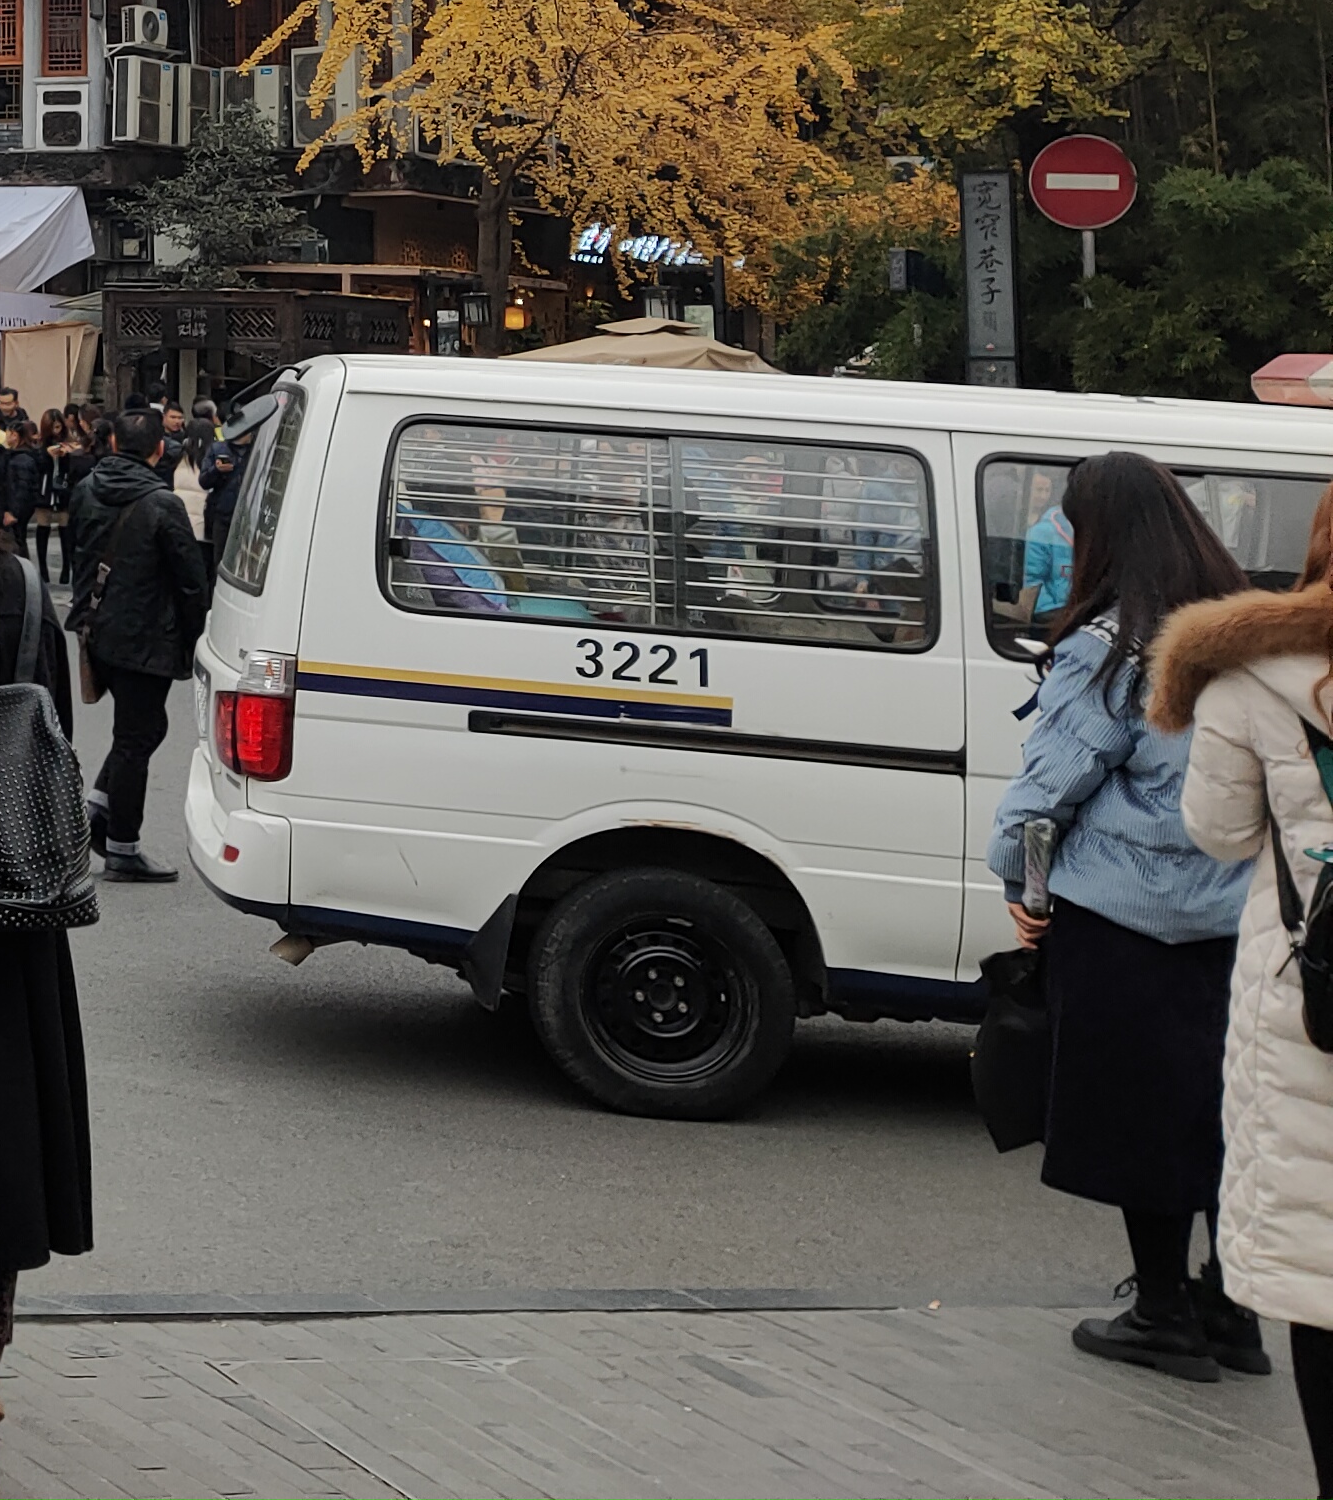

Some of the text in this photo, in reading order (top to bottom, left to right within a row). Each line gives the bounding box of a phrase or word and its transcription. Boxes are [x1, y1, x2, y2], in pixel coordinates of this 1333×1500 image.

[972, 181, 1004, 305] 宽窄巷子
[575, 638, 709, 688] 3221
